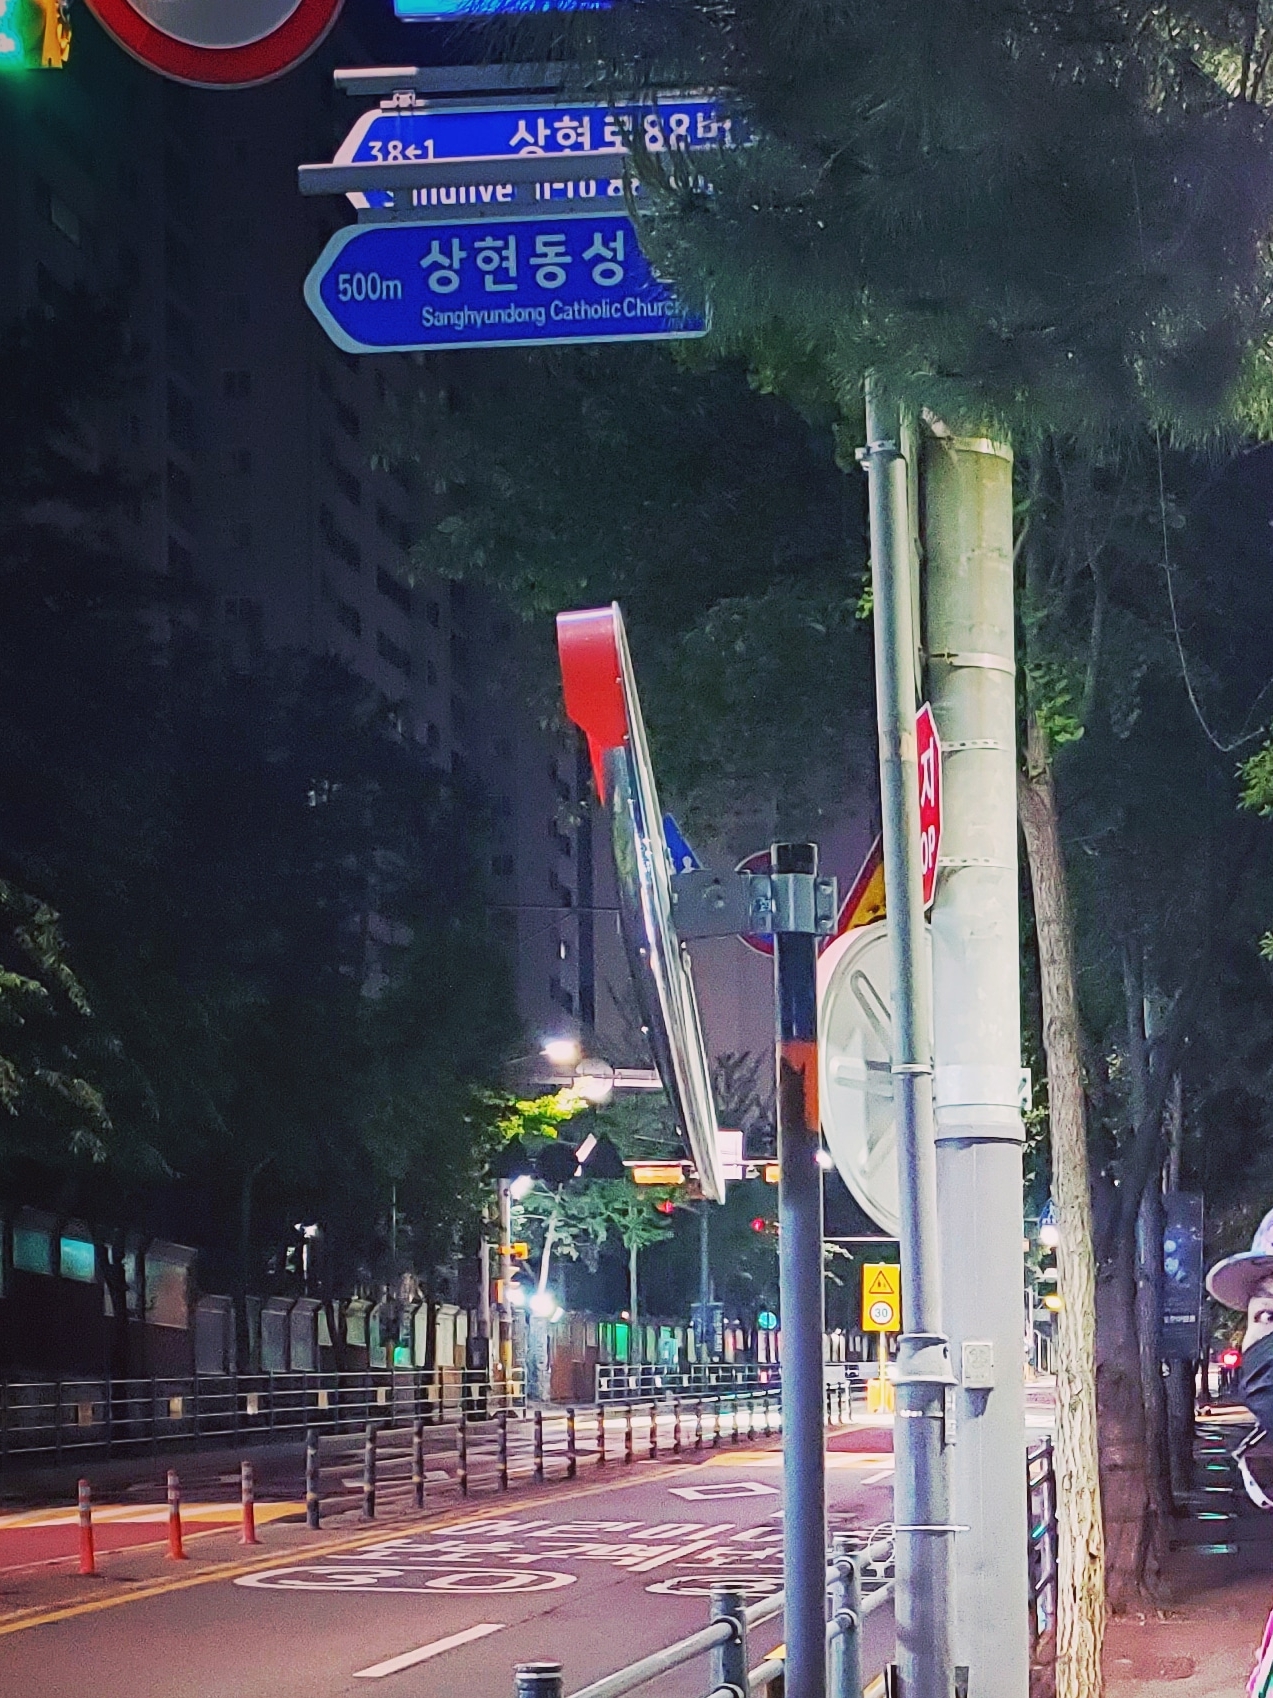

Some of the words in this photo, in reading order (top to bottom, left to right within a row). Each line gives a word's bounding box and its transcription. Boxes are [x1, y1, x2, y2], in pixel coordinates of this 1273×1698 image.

[420, 230, 626, 293] 상현동성
[337, 272, 402, 301] 500m
[421, 303, 546, 331] Sanghyundong
[550, 298, 621, 322] Catholic
[920, 737, 935, 808] 지
[920, 824, 936, 876] OP
[874, 1308, 888, 1318] 30
